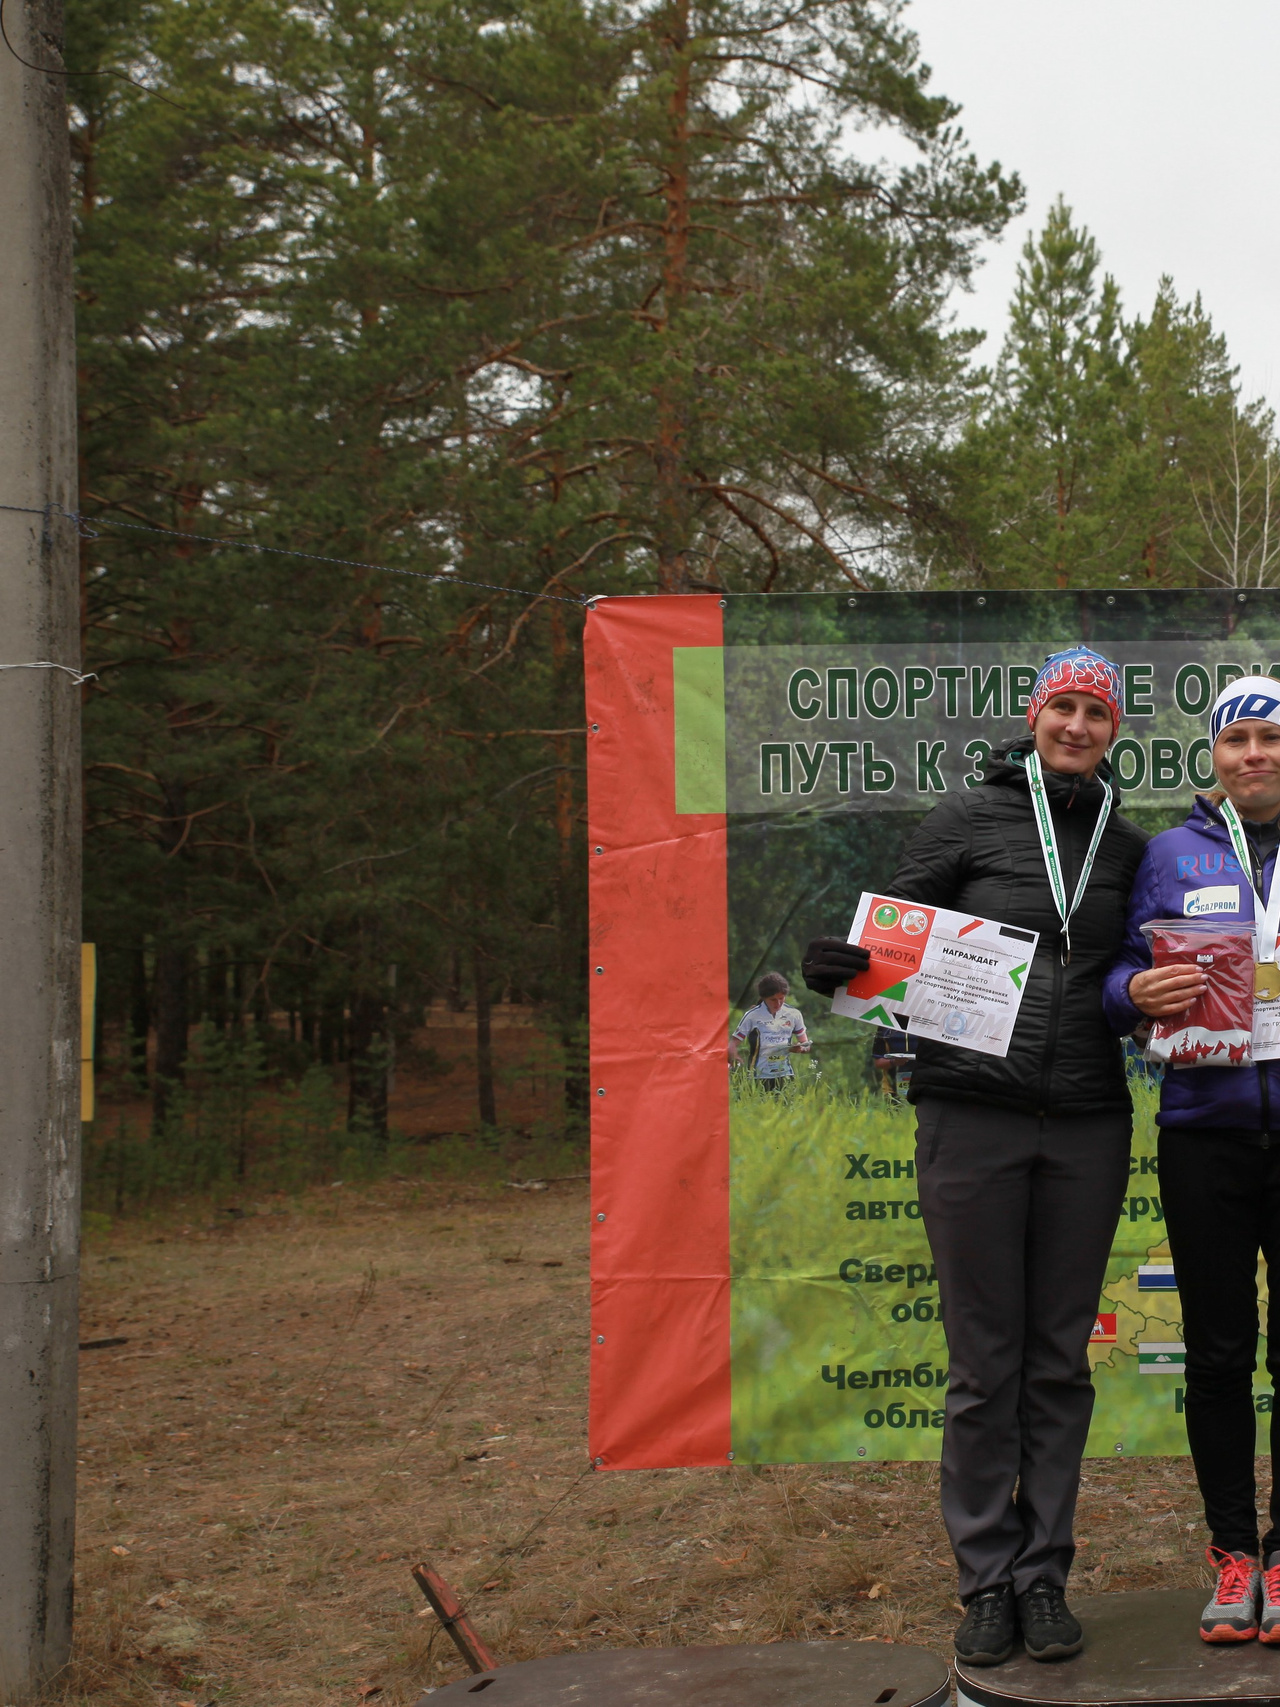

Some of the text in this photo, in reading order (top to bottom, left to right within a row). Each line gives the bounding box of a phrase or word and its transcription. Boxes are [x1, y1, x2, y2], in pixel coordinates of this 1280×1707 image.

[788, 664, 1155, 720] СПОРТИВЕ
[760, 741, 896, 795] ПУТЬ
[916, 739, 947, 793] К
[1200, 901, 1236, 912] GAZPROM
[864, 944, 916, 964] ГРАМОТА
[943, 947, 998, 967] НАГРАЖДАЕТ
[924, 973, 964, 987] региональных
[966, 982, 1008, 998] соревнованиях
[967, 975, 988, 985] место
[923, 981, 960, 994] спортивному
[961, 990, 1009, 1005] ориентированию
[937, 1001, 958, 1010] группе
[822, 1362, 950, 1390] Челяби
[864, 1402, 946, 1428] обла
